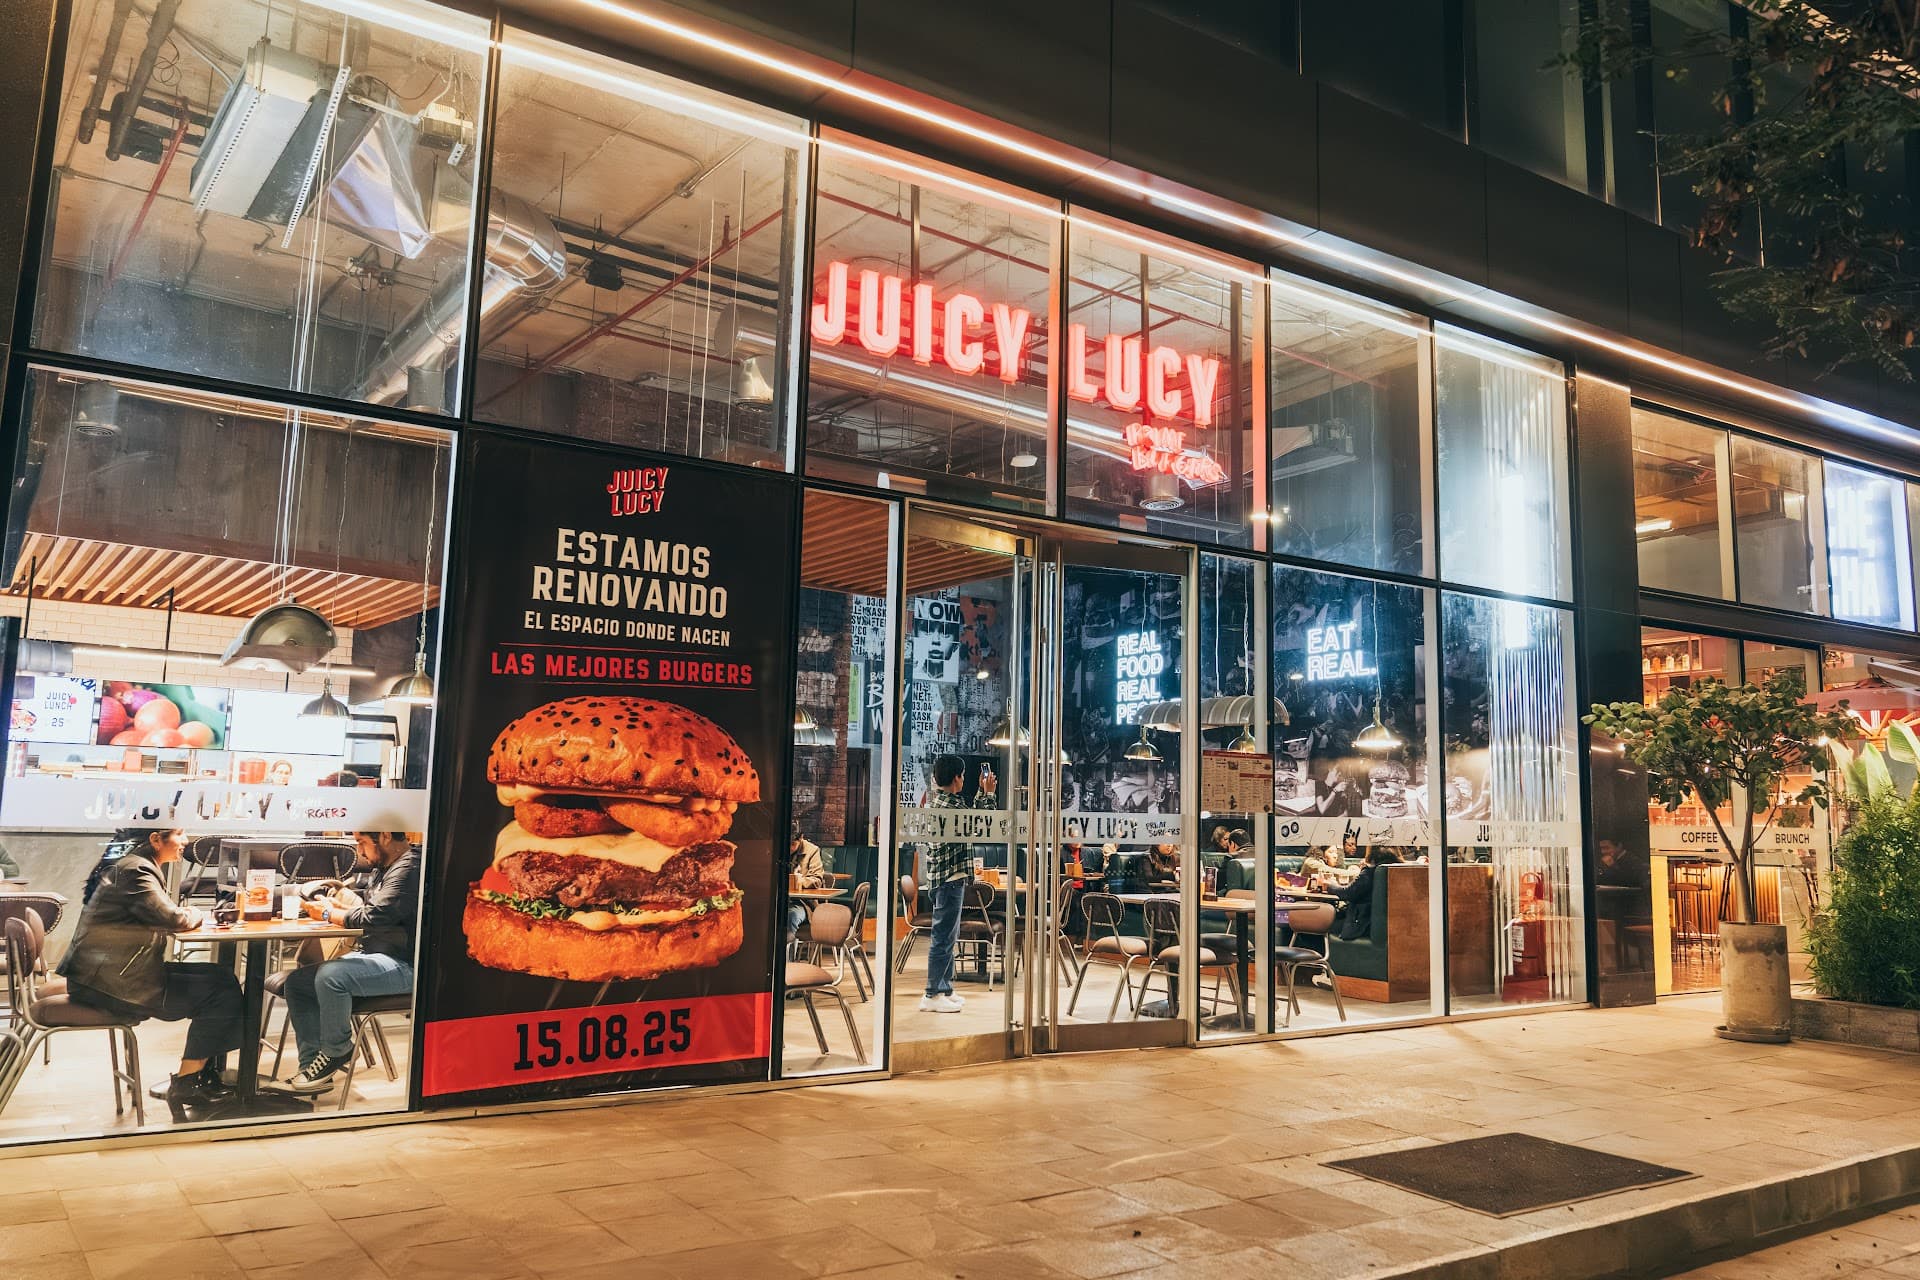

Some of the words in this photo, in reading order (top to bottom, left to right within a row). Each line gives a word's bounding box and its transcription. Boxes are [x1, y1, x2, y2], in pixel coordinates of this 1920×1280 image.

[810, 261, 1030, 385] JUICY
[1068, 323, 1220, 428] LUCY
[607, 467, 669, 493] JUICY
[612, 490, 664, 516] LUCY
[556, 527, 711, 579] ESTAMOS
[531, 565, 728, 619] RENOVANDO
[524, 610, 545, 630] EL
[551, 613, 619, 636] ESPACIO
[625, 620, 676, 642] DONDE
[682, 627, 731, 647] NACEN
[1308, 622, 1356, 654] EAT
[1117, 631, 1161, 656] REAL
[491, 651, 535, 676] LAS
[545, 654, 649, 680] MEJORES
[659, 659, 753, 685] BURGERS
[1117, 653, 1164, 679] FOOD
[1117, 677, 1161, 702] REAL
[954, 814, 993, 837] LUCY
[1681, 831, 1719, 843] COFFEE
[1775, 833, 1810, 844] BRUNCH
[514, 1007, 691, 1071] 15.08.25
